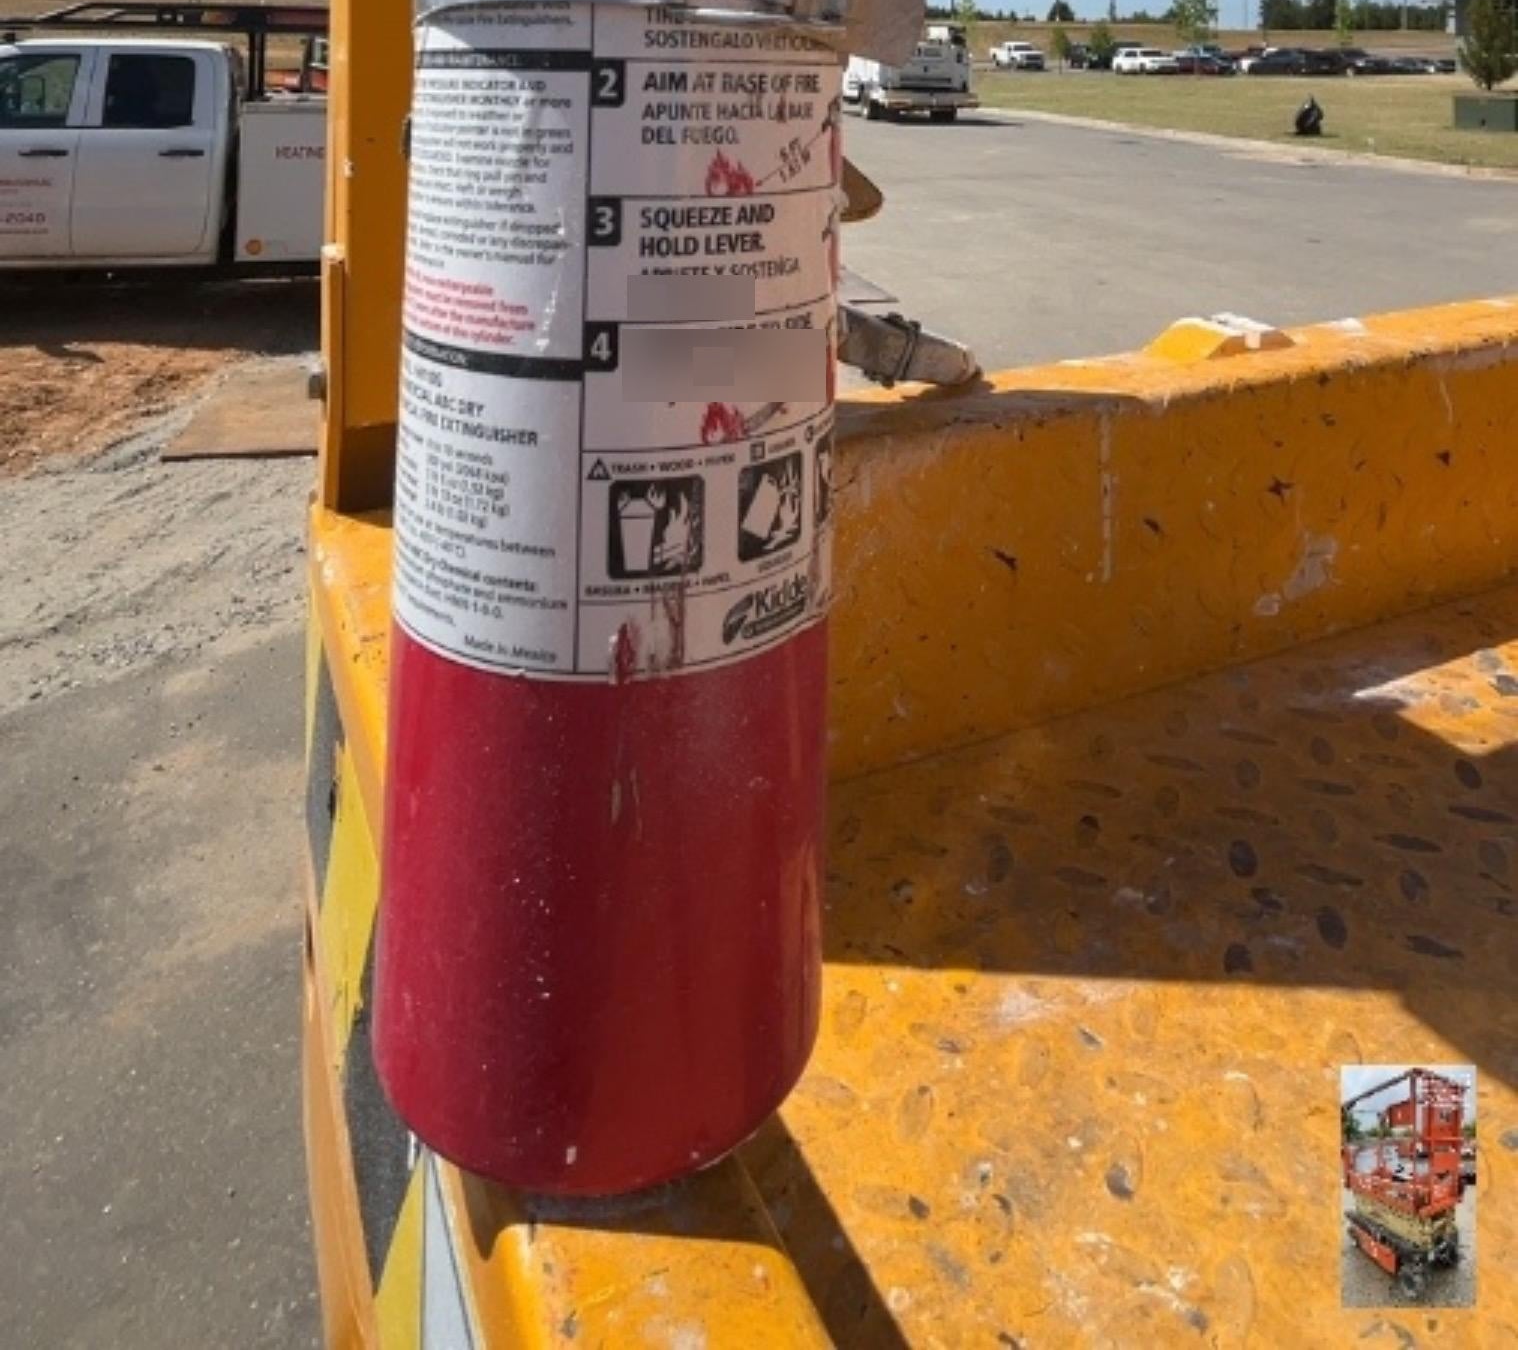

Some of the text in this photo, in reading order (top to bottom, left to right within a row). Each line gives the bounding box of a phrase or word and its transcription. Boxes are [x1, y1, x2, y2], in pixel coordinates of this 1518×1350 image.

[599, 68, 619, 97] 2
[642, 71, 688, 93] AIM
[693, 72, 715, 93] AT
[722, 72, 768, 94] BASE
[642, 101, 712, 121] APUNTE
[641, 126, 677, 145] DEL
[595, 206, 614, 235] 3
[640, 203, 775, 231] SQUEEZE AND
[639, 232, 766, 258] HOLD LEVER.
[590, 331, 612, 362] 4
[611, 461, 648, 474] TRASH
